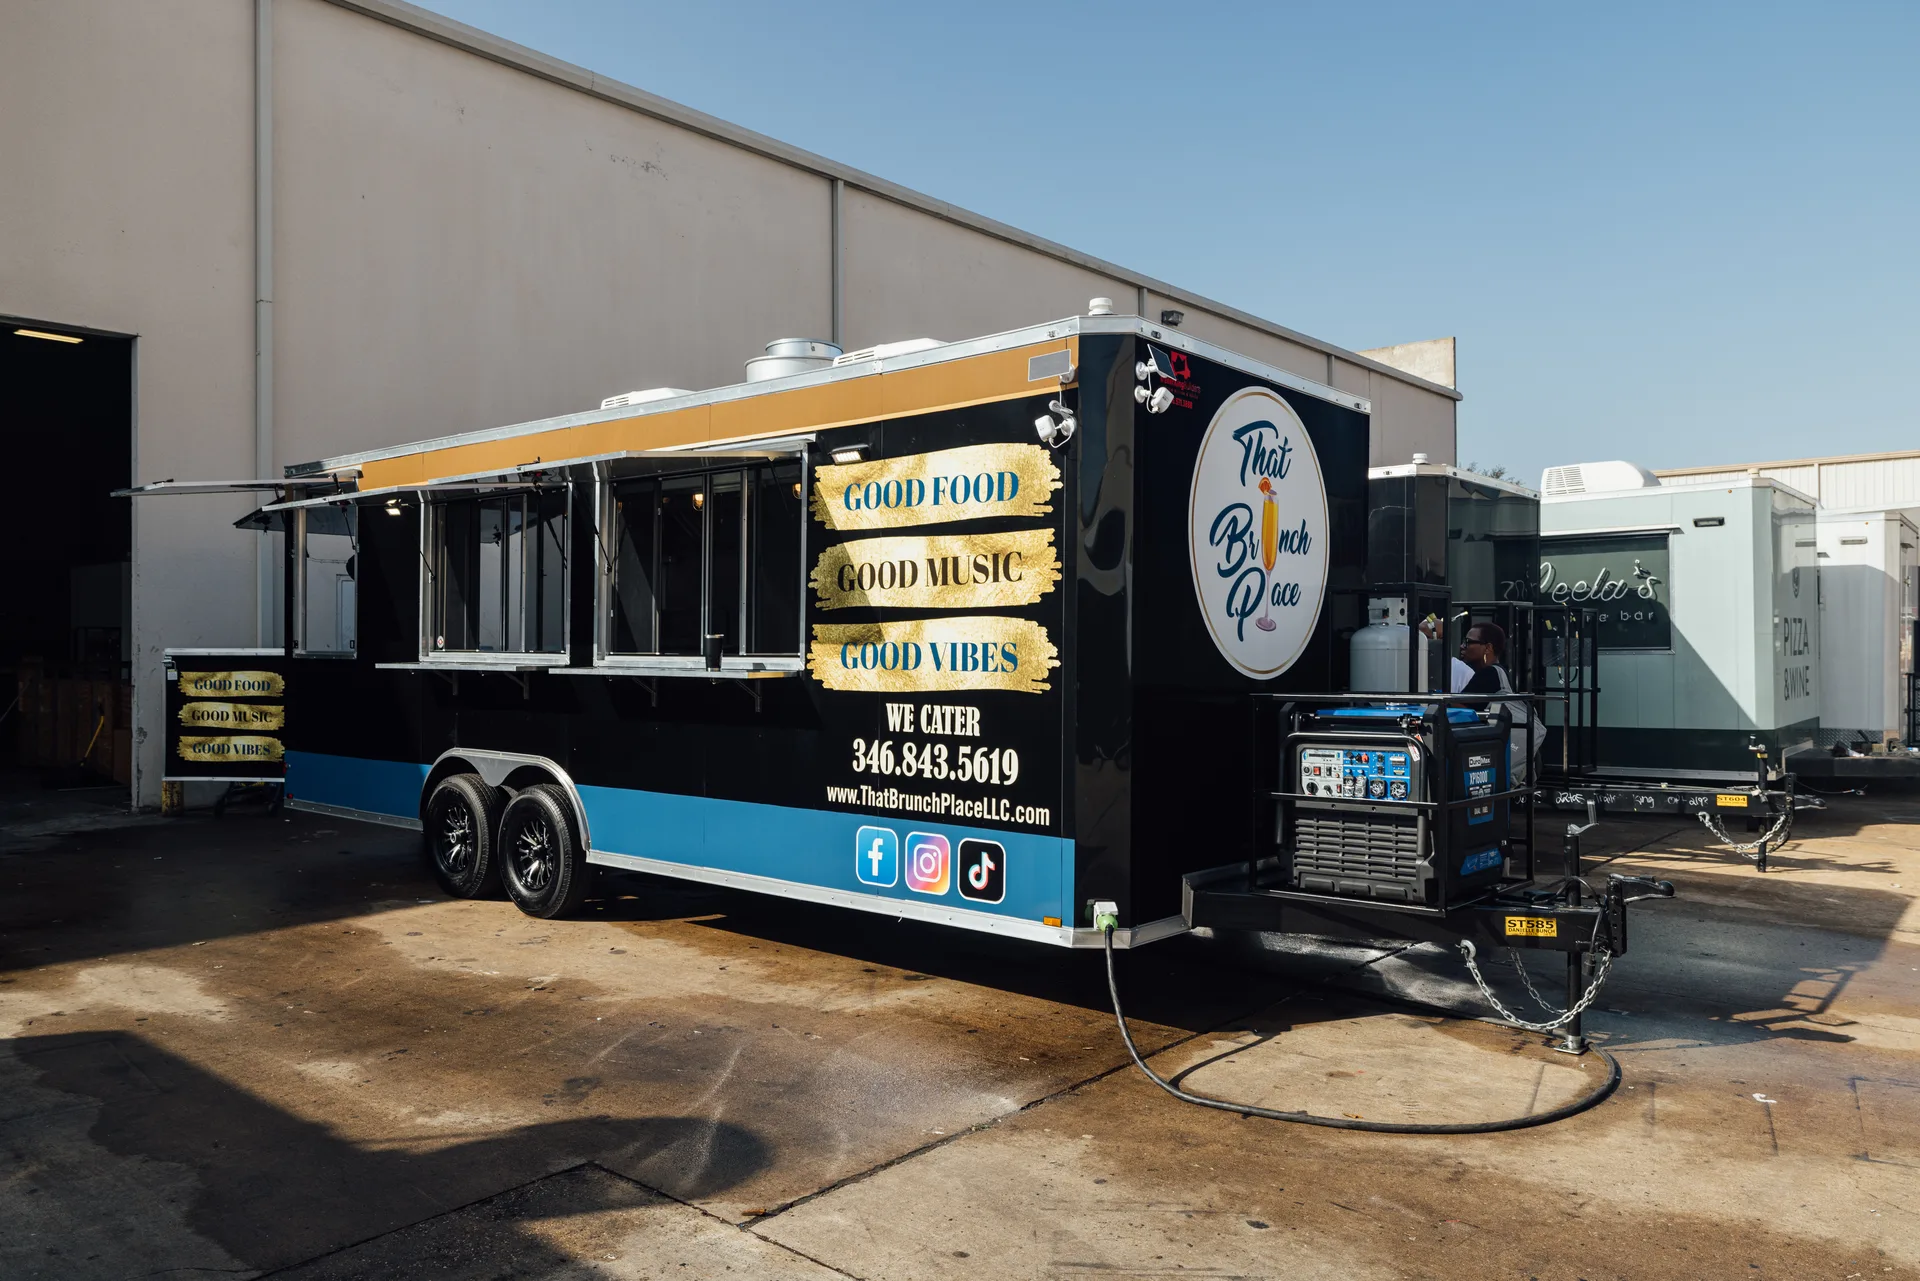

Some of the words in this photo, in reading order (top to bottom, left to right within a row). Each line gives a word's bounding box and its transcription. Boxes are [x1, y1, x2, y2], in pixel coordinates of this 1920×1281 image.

[1232, 420, 1292, 487] That
[843, 478, 925, 512] GOOD
[931, 470, 1019, 506] FOOD
[1210, 502, 1312, 578] Brnch
[837, 559, 918, 593] GOOD
[925, 550, 1023, 588] MUSIC
[1226, 566, 1301, 642] Pace
[1620, 610, 1655, 622] bar
[1783, 617, 1810, 656] PIZZA
[840, 641, 922, 671] GOOD
[927, 641, 1019, 674] VIBES
[194, 679, 232, 691] GOOD
[234, 679, 271, 692] FOOD
[191, 709, 229, 722] GOOD
[232, 711, 273, 723] MUSIC
[886, 702, 915, 733] WE
[920, 705, 981, 736] CATER
[192, 743, 230, 755] GOOD
[233, 744, 271, 755] VIBES
[852, 738, 1019, 786] 346.843.5619
[827, 784, 1050, 827] www.ThatBrunchPlaceLLC.com
[1507, 919, 1554, 929] ST585
